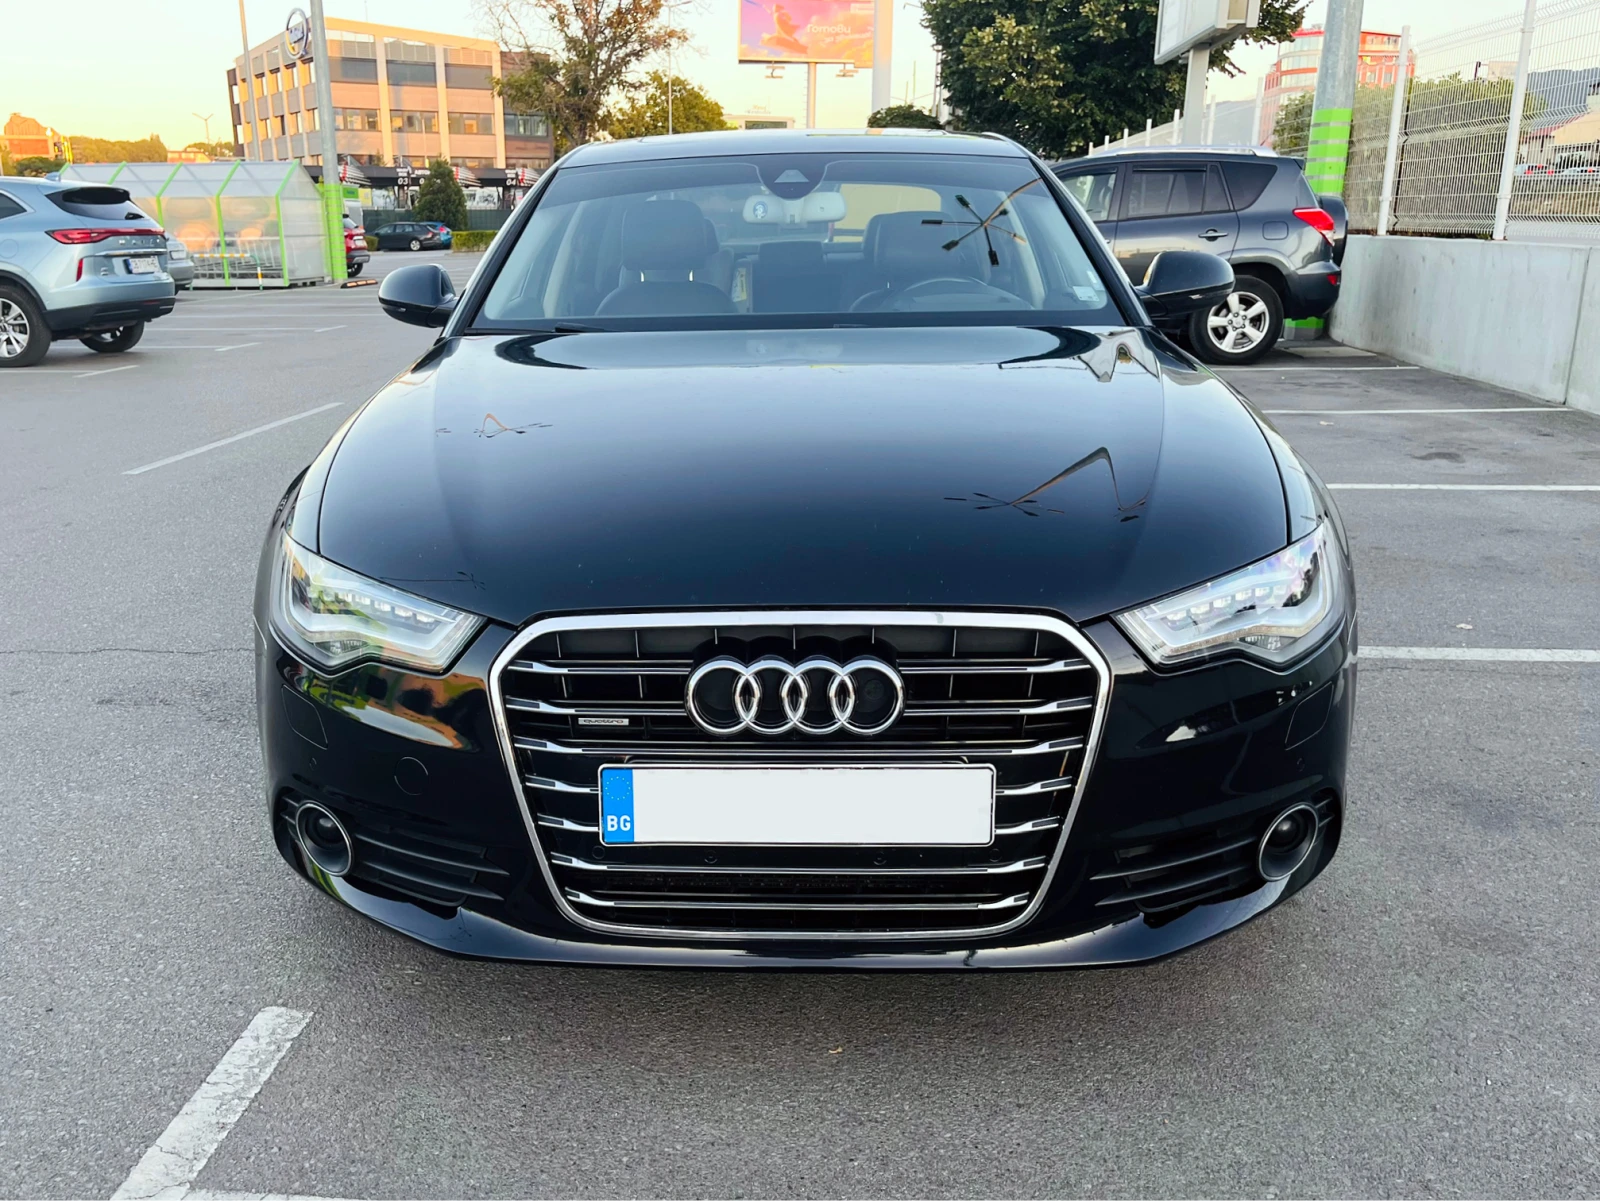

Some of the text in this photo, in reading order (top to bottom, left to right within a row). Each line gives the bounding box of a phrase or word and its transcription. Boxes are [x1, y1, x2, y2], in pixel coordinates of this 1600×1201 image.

[397, 177, 409, 185] 03
[506, 178, 517, 186] 04
[606, 814, 631, 832] BG
